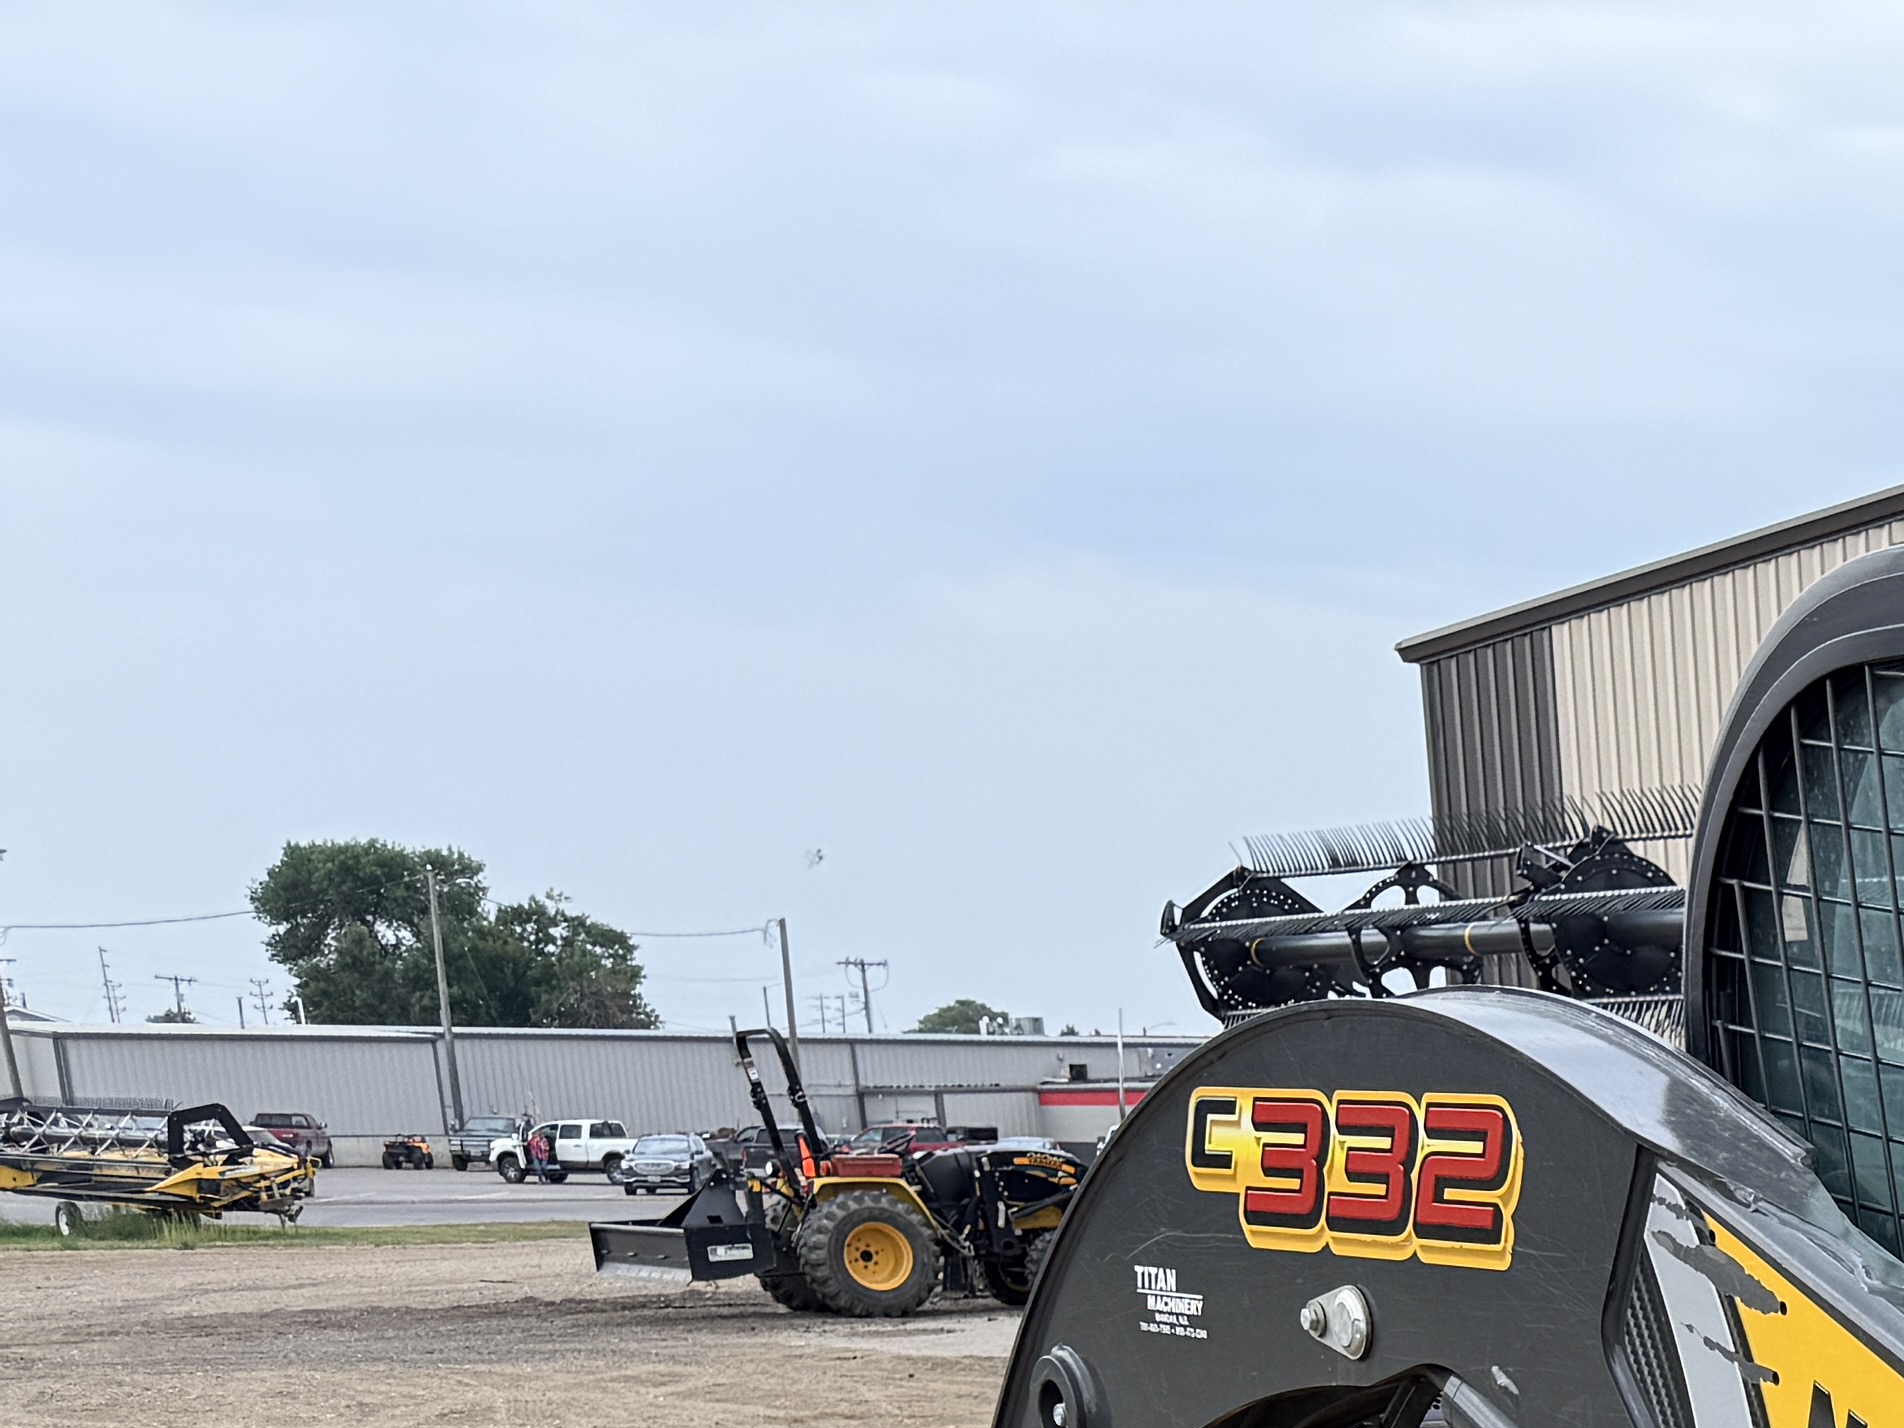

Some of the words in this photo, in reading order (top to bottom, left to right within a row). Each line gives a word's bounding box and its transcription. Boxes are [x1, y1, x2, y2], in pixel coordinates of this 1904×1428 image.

[1187, 1088, 1521, 1264] C332
[1133, 1264, 1177, 1292] TITAN
[1146, 1294, 1204, 1317] MACHINERY
